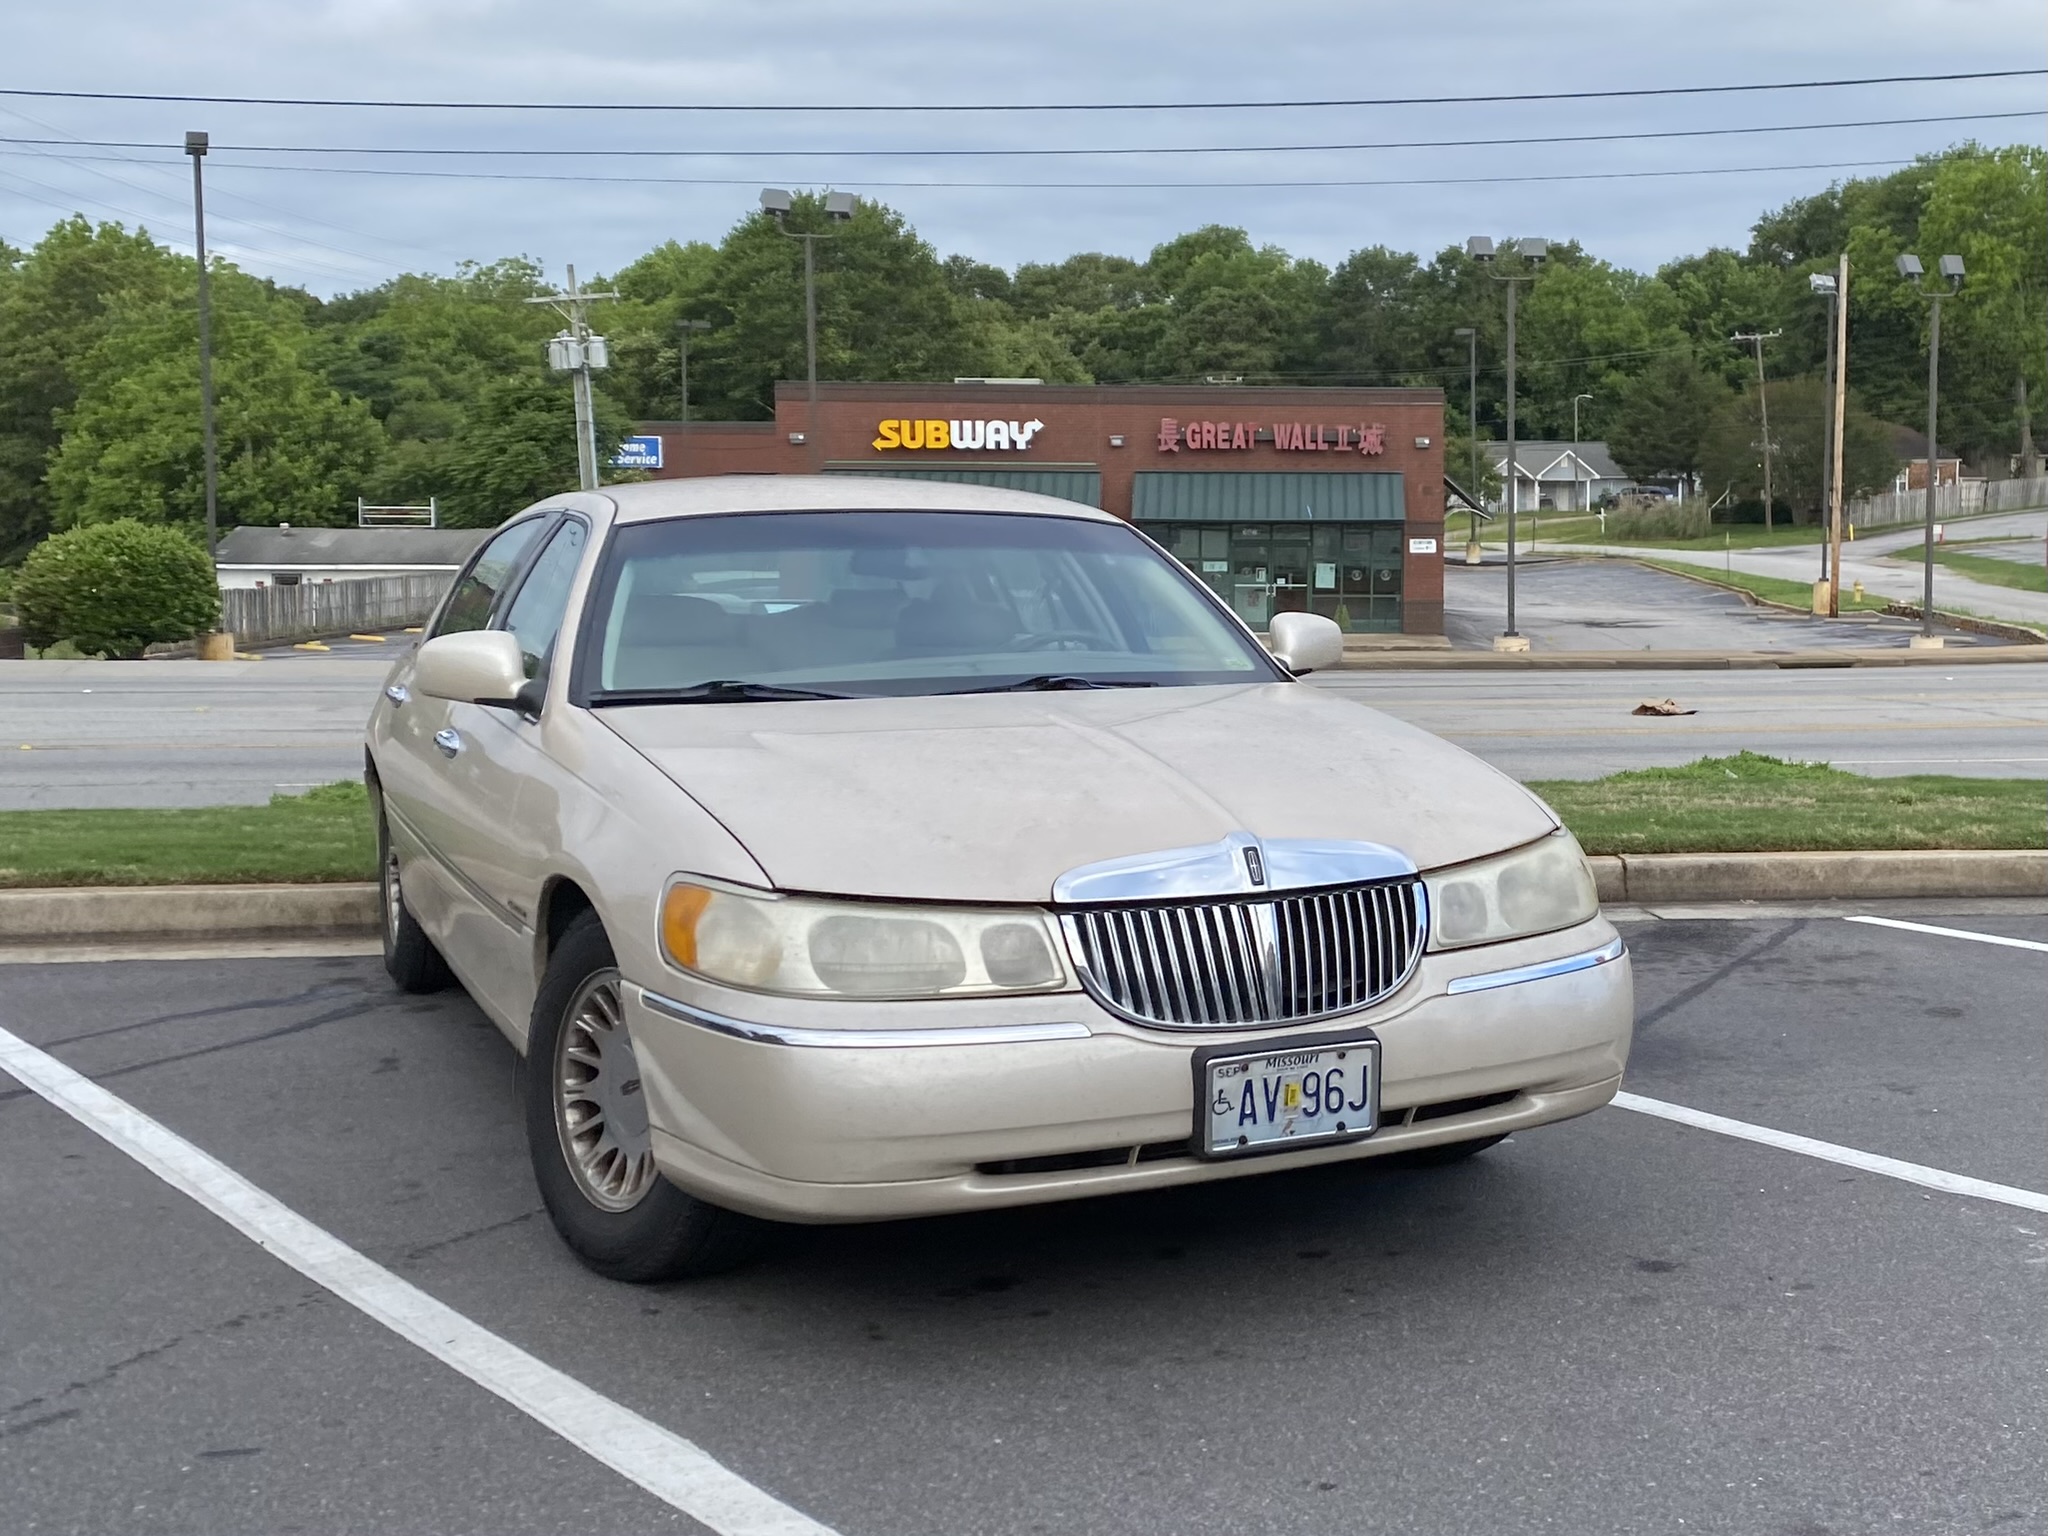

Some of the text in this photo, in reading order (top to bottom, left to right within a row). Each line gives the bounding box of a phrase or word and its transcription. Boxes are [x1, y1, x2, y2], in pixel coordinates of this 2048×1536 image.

[872, 418, 1044, 451] SUBWAY
[1186, 421, 1257, 449] GREAT
[1273, 422, 1328, 450] WALL
[1217, 1065, 1240, 1078] SEP
[1265, 1053, 1319, 1069] Missouri
[1302, 1065, 1368, 1117] 96J
